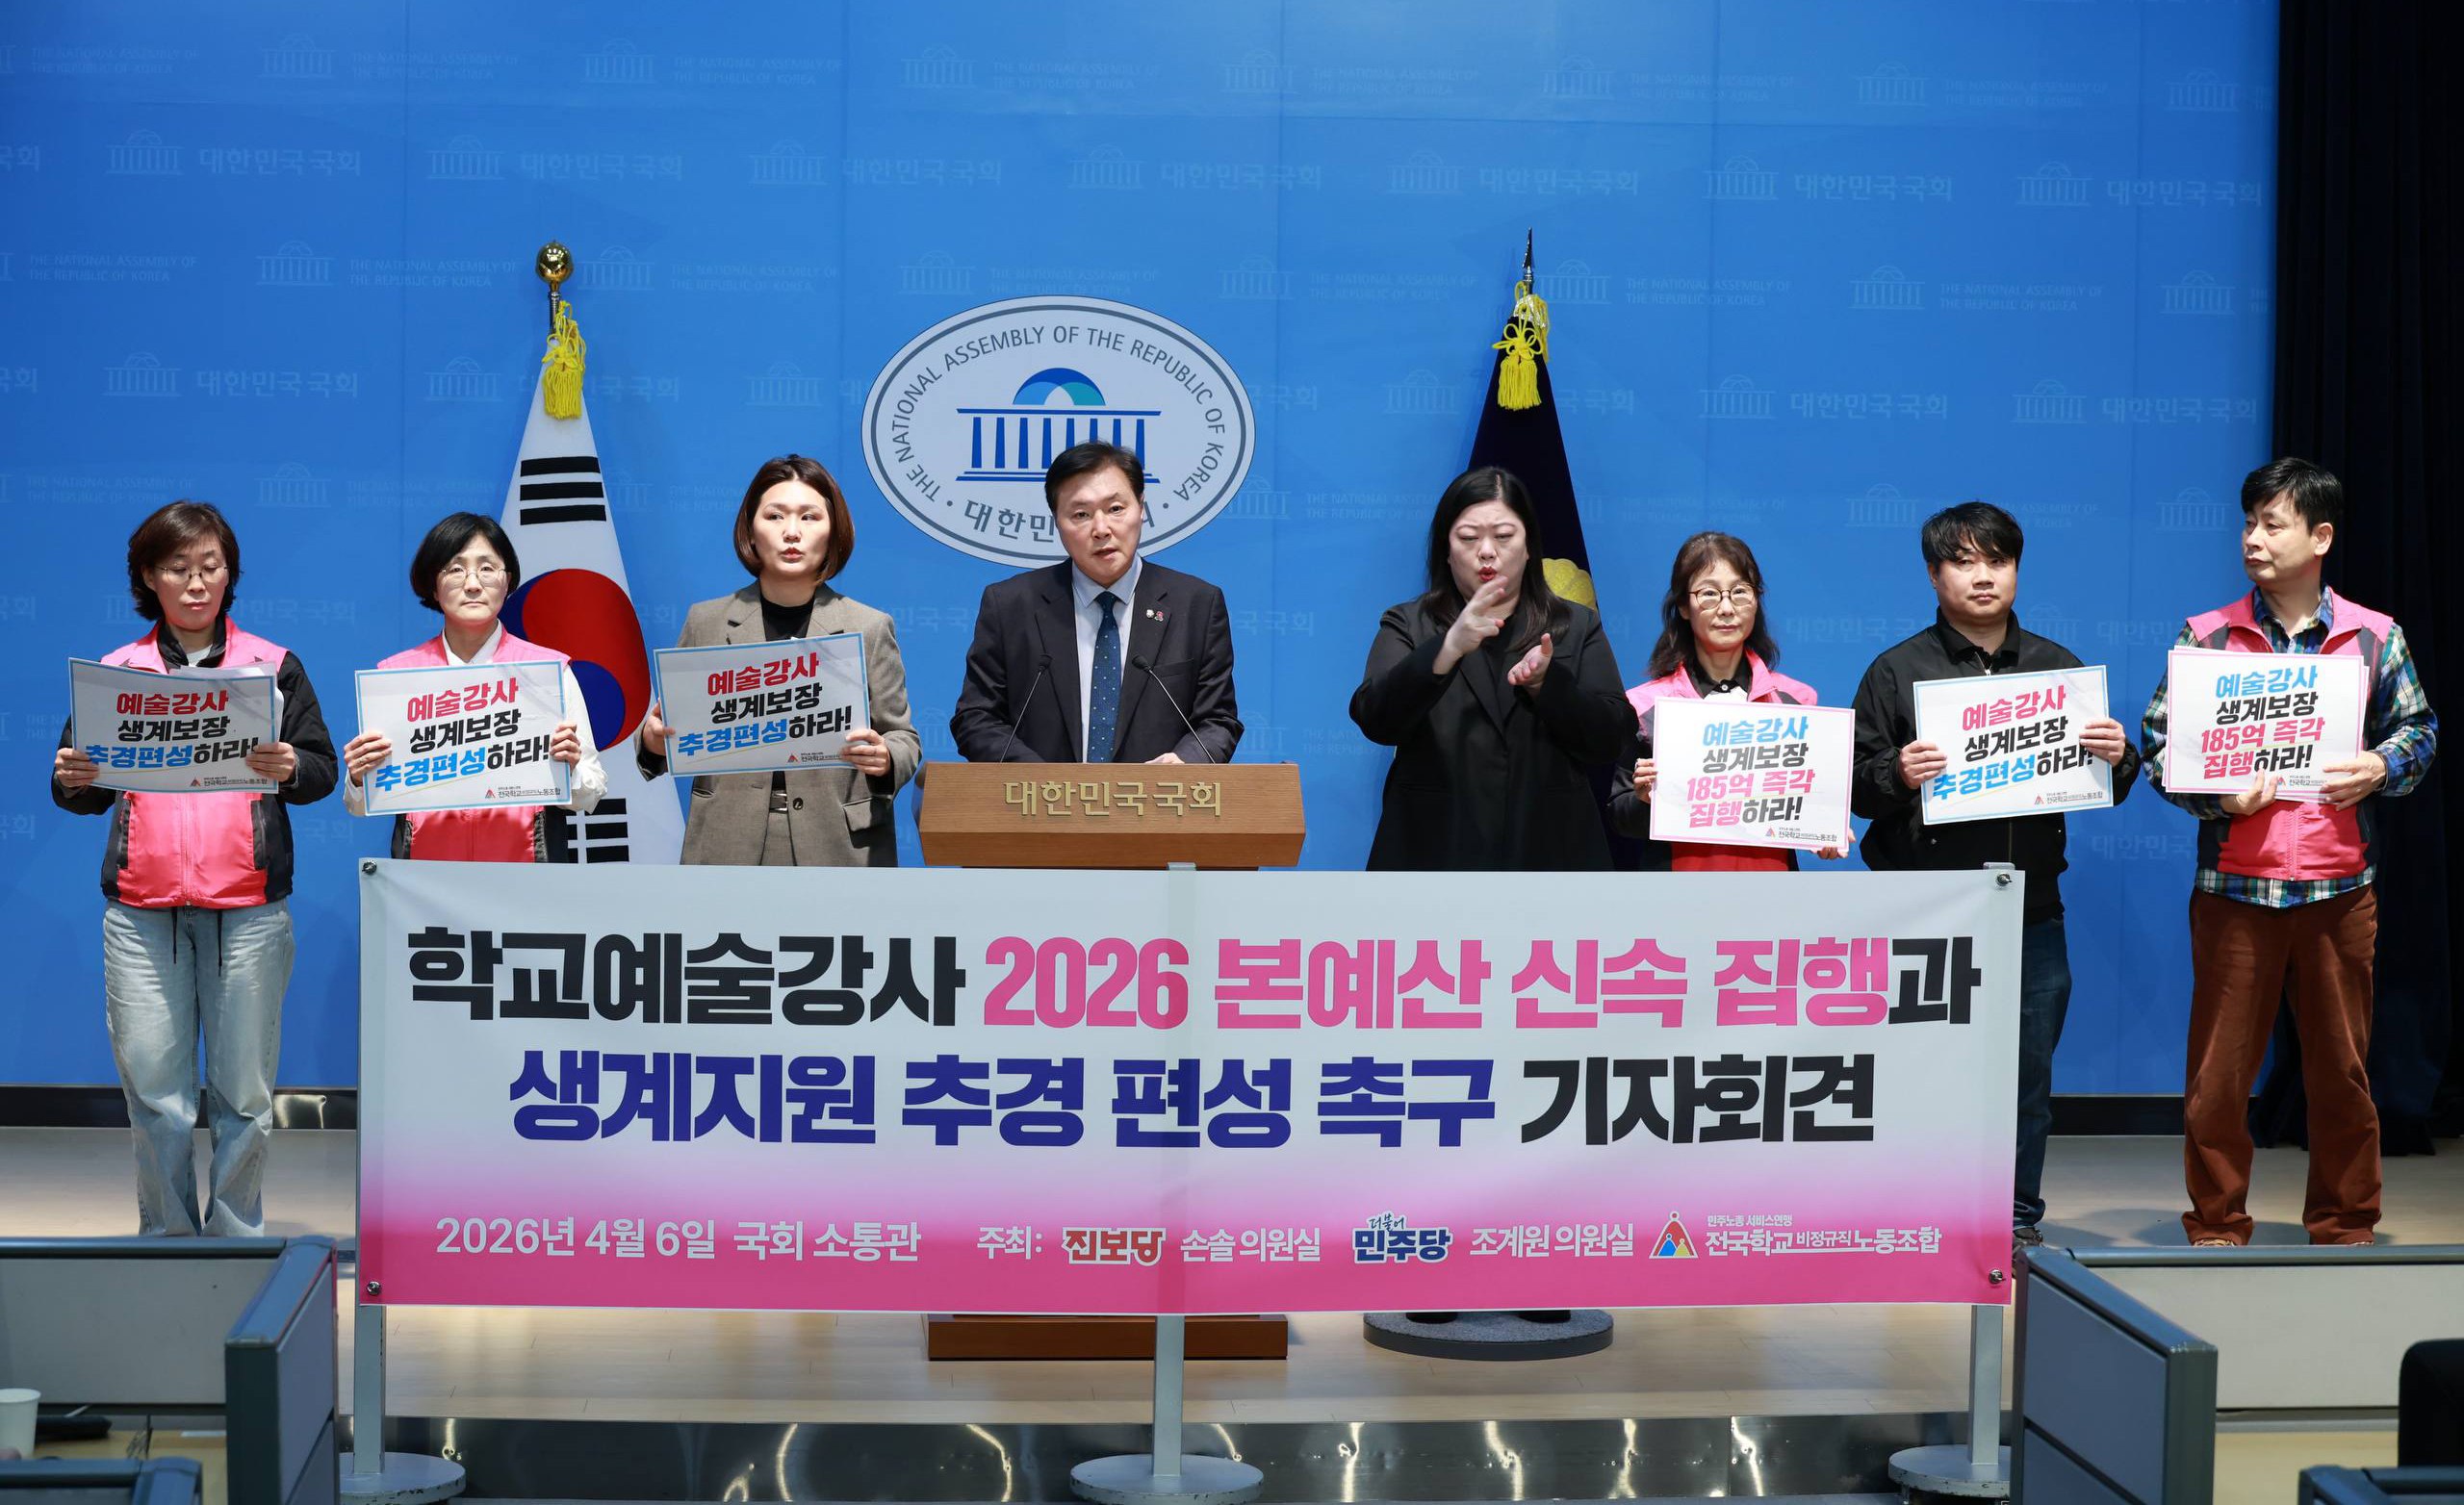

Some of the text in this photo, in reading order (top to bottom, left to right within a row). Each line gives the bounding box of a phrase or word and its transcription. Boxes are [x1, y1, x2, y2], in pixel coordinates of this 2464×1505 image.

[944, 325, 1045, 372] ASSEMBLY
[1053, 325, 1079, 344] OF
[1088, 327, 1125, 352] THE
[1129, 339, 1214, 405] REPUBLIC
[892, 367, 943, 463] NATIONAL
[1205, 407, 1225, 435] OF
[908, 464, 943, 502] THE
[1173, 442, 1225, 502] KOREA
[707, 652, 819, 696] 예술강사
[2216, 665, 2318, 698] 예술강사
[116, 690, 229, 715] 예술강사
[407, 677, 519, 722] 예술강사
[711, 682, 823, 725] 생계보장
[1962, 685, 2066, 731] 예술강사
[2216, 692, 2319, 725] 생계보장
[117, 716, 230, 742] 생계보장
[410, 708, 521, 754] 생계보장
[678, 705, 852, 756] 추경편성하라!
[1703, 716, 1809, 746] 예술강사
[1964, 716, 2068, 762] 생계보장
[2201, 717, 2325, 753] 185억 즉각
[375, 734, 551, 792] 추경편성하라!
[1703, 743, 1809, 774] 생계보장
[2203, 745, 2313, 779] 집행하라!
[1686, 769, 1815, 802] 185억 즉각
[1689, 797, 1803, 828] 집행하라!
[408, 926, 1981, 1029] 학교예술강사 2026 본예산 신속 집행과
[510, 1050, 1874, 1148] 생계지원 추경 편성 촉구 기자회견
[436, 1216, 922, 1263] 2026년 4월 6일 국회 소통관
[1368, 1212, 1405, 1231] 더불어
[977, 1226, 1042, 1260] 주최:
[1063, 1227, 1165, 1265] 진보당
[1239, 1227, 1321, 1263] 의원실
[1354, 1222, 1633, 1263] 민주당 조계원 의원실
